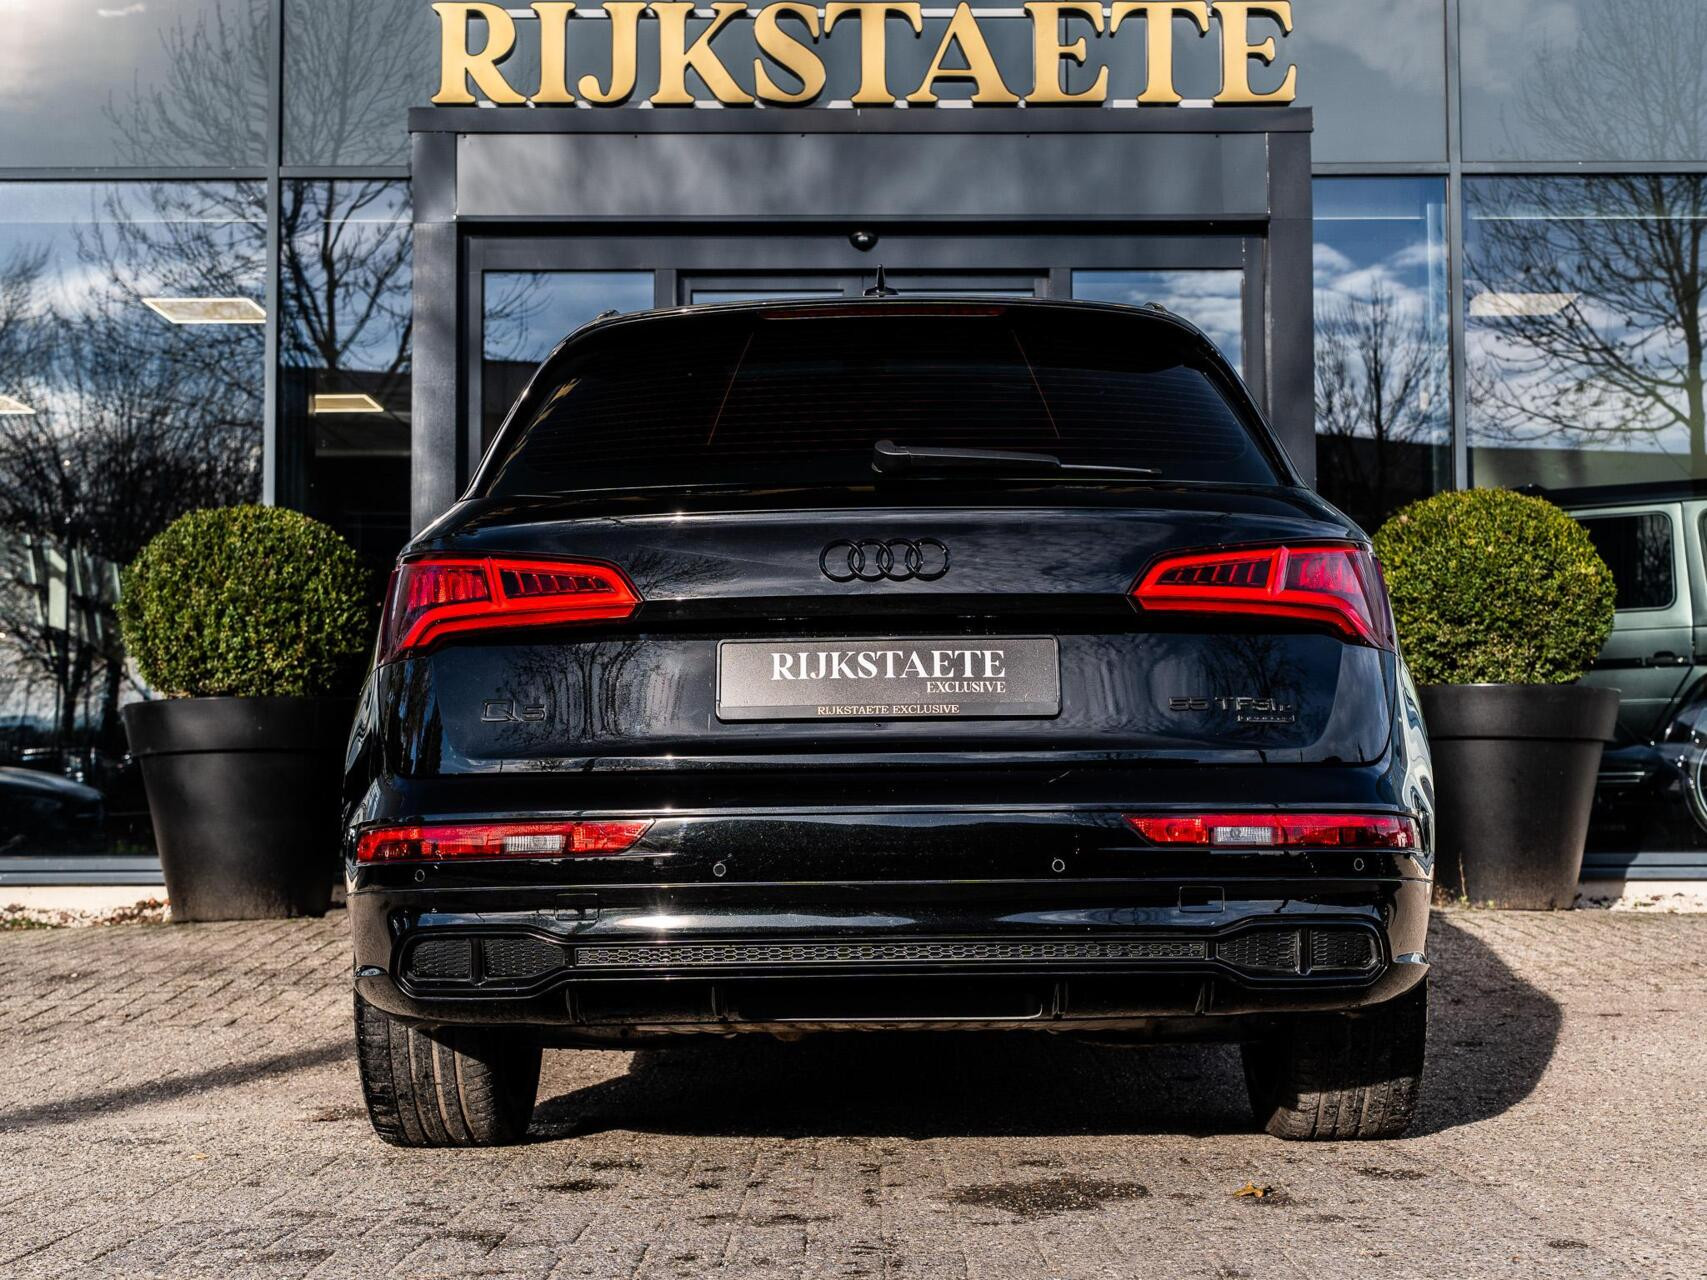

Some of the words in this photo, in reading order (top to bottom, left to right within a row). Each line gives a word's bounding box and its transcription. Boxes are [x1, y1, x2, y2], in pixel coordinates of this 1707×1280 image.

[430, 1, 1298, 107] RIJKSTAETE
[770, 650, 1006, 681] RIJKSTAETE
[926, 681, 1006, 693] EXCLUSIVE
[480, 700, 547, 722] Q5
[817, 705, 889, 715] RIJKSTAETE
[892, 704, 960, 714] EXCLUSIVE
